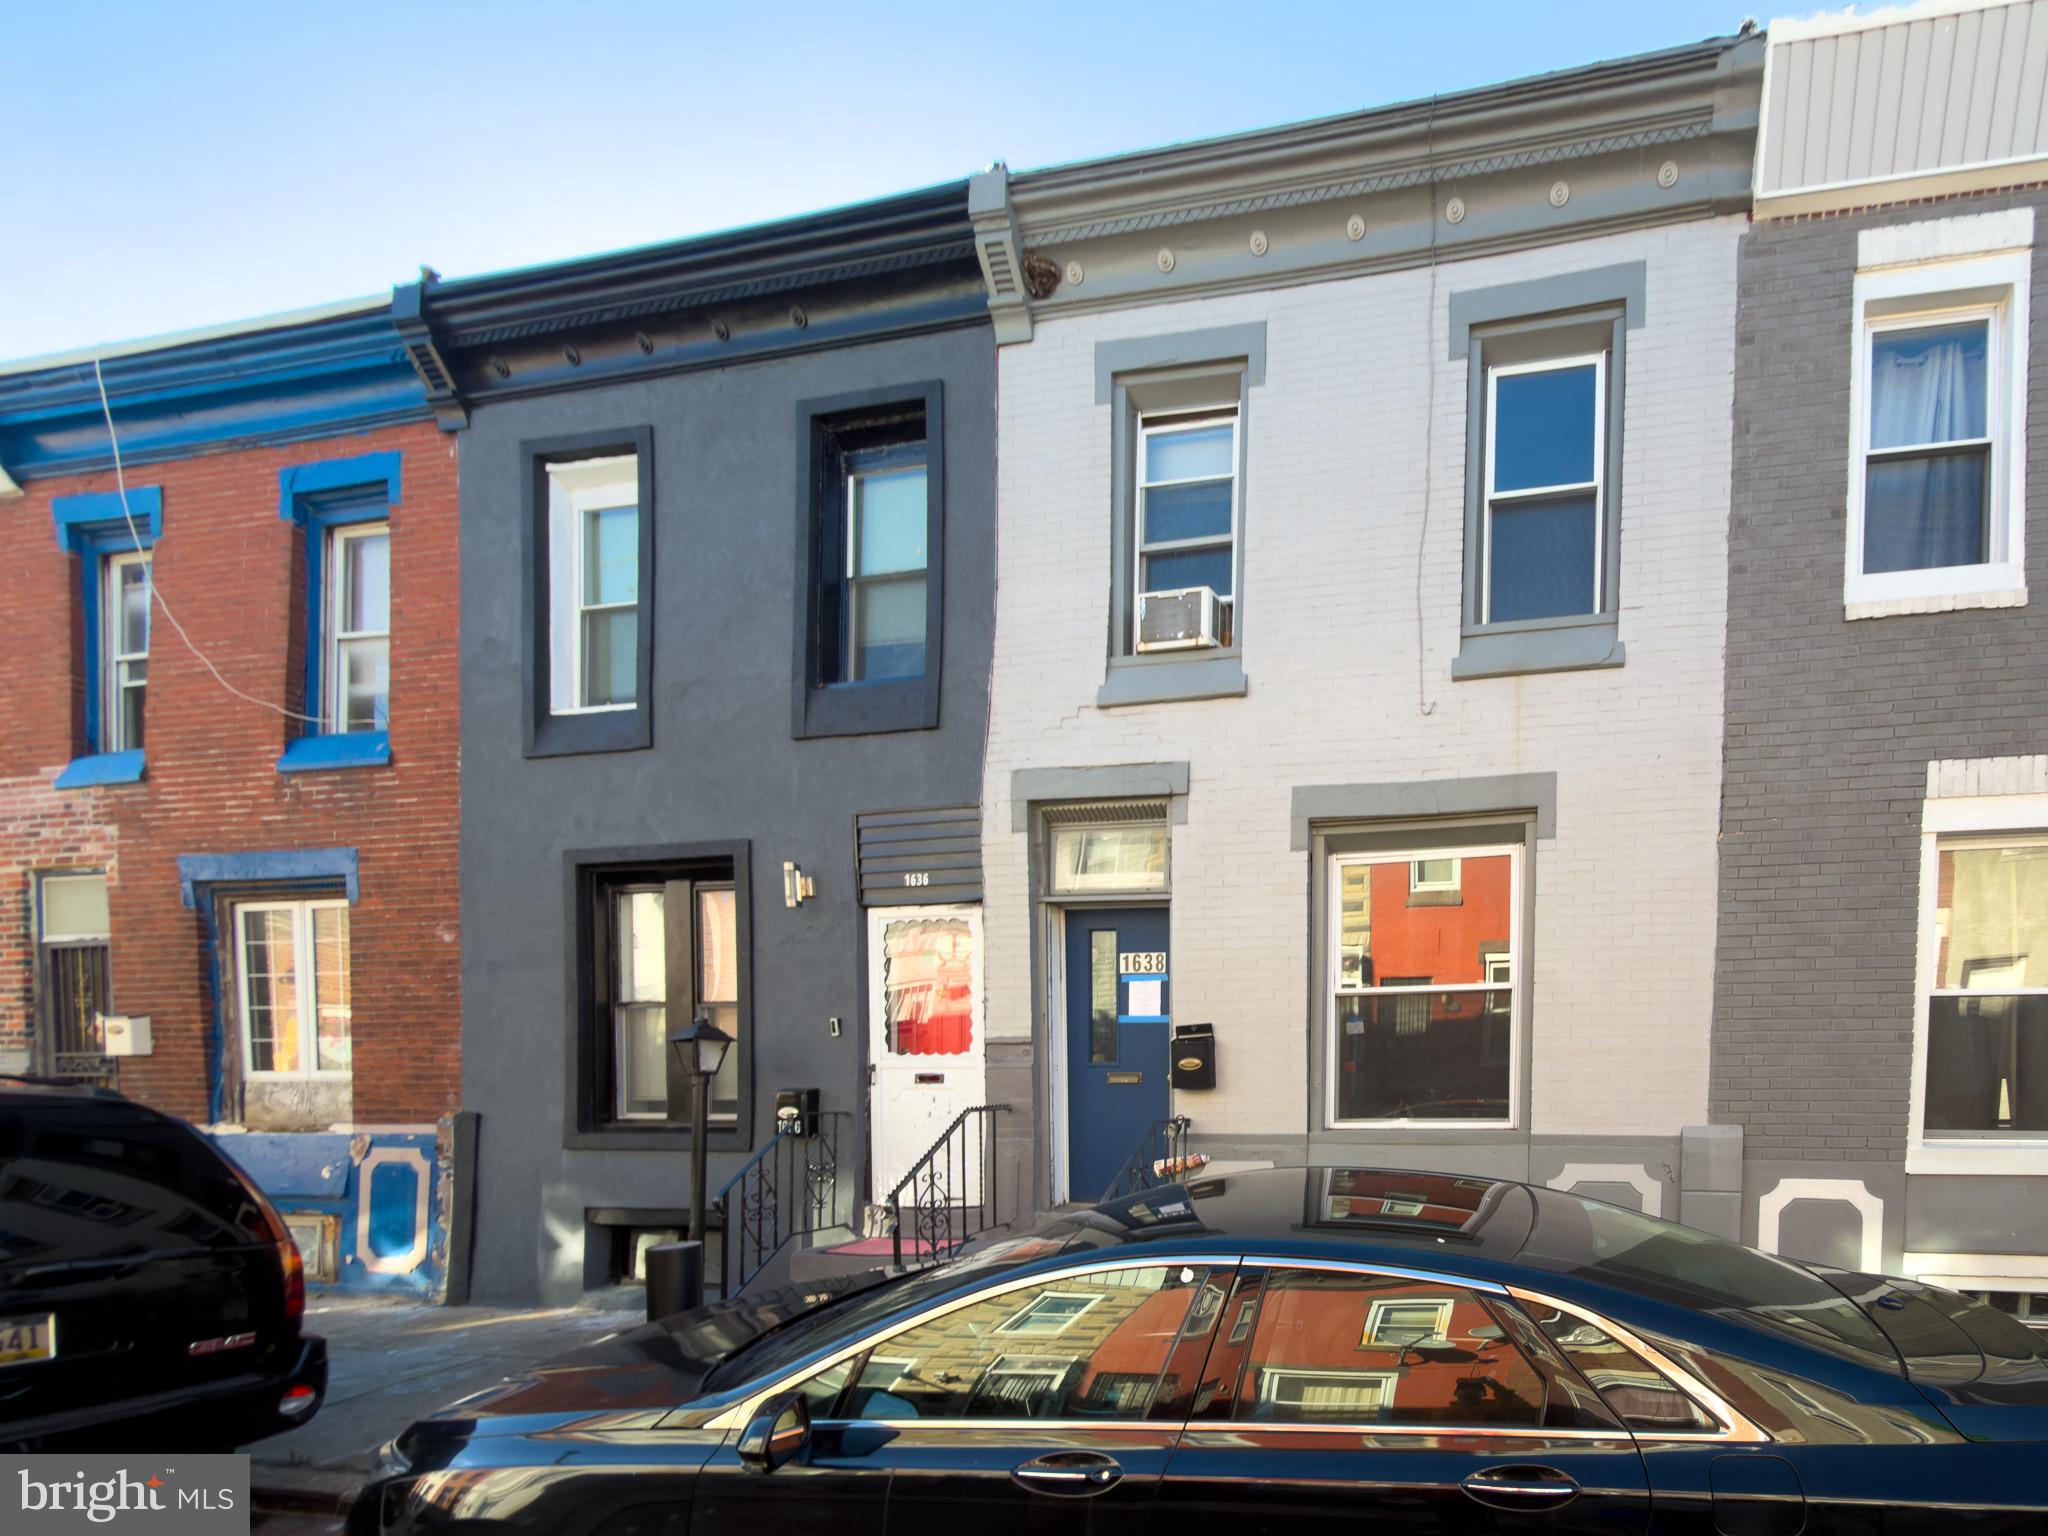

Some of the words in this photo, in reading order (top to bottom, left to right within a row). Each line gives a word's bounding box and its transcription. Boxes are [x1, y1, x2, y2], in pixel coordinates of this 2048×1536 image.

[904, 873, 929, 887] 1636
[1122, 953, 1165, 972] 1638
[777, 1120, 801, 1134] 166
[0, 1326, 38, 1351] 41
